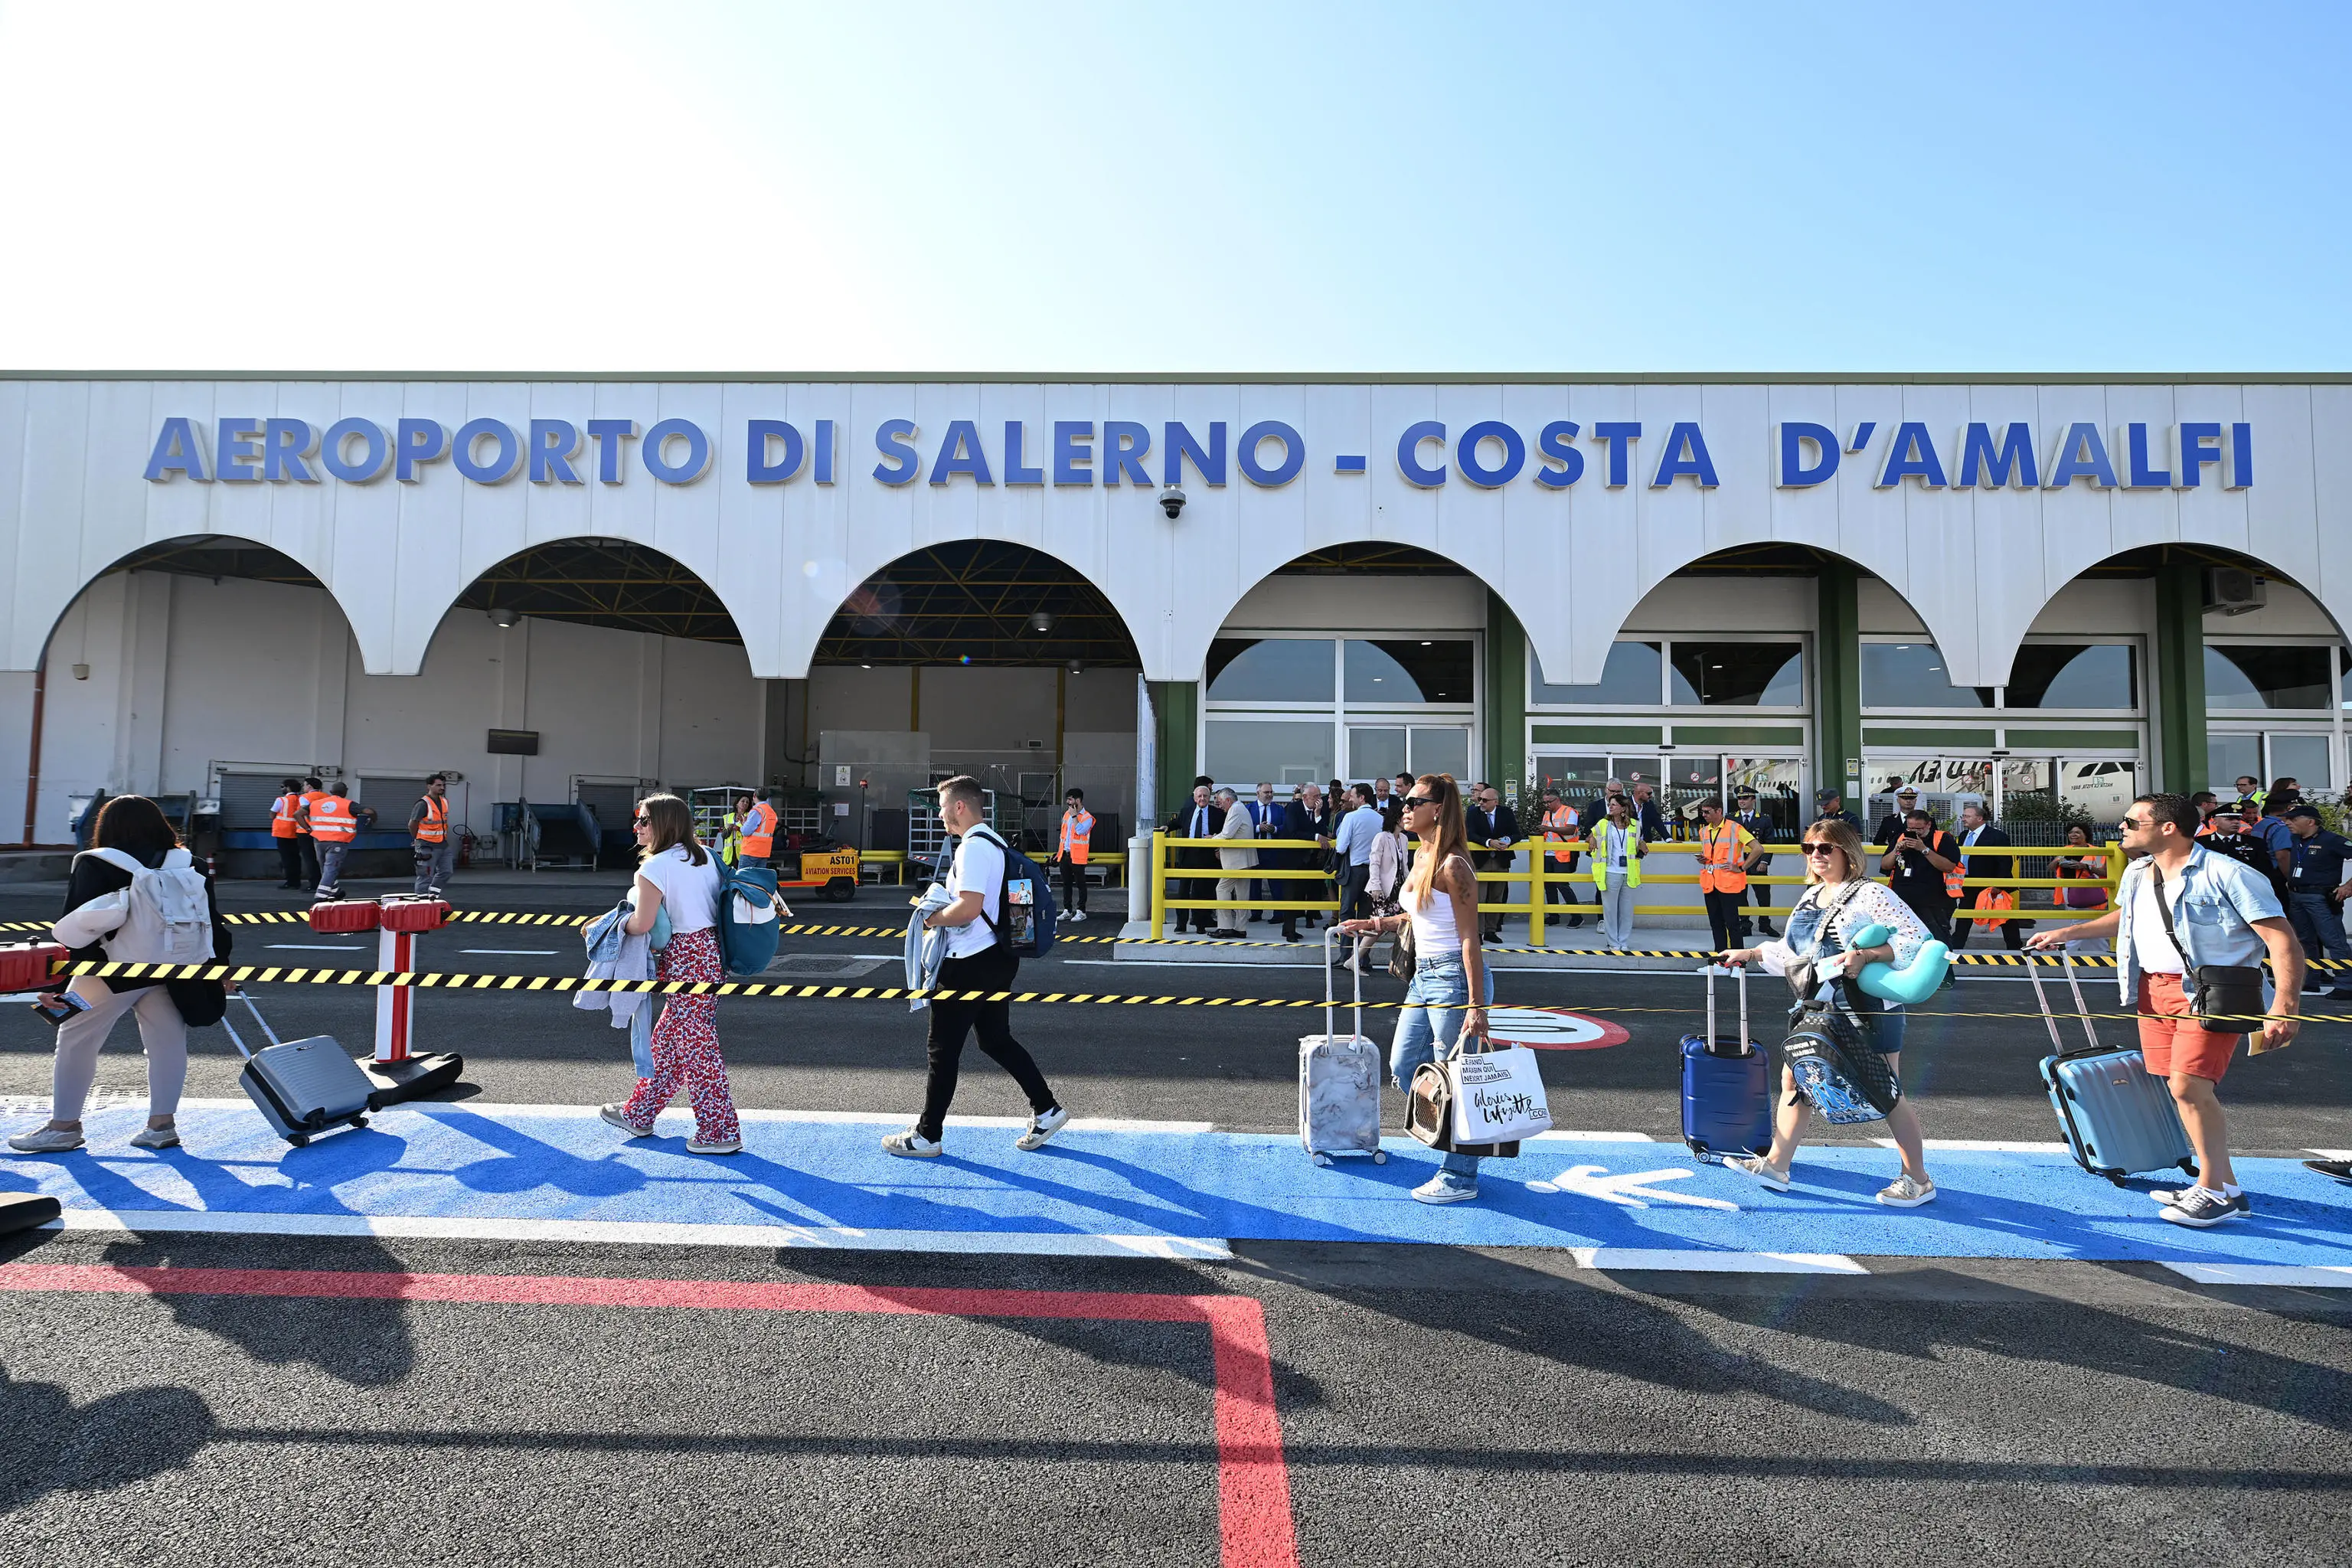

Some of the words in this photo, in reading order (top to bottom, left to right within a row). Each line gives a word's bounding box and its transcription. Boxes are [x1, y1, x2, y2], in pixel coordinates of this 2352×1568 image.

[145, 418, 710, 485] AEROPORTO
[748, 420, 835, 484] DI
[874, 420, 1305, 486] SALERNO
[1335, 455, 1367, 473] -
[1398, 420, 1720, 488] COSTA
[1778, 421, 2254, 490] D'AMALFI
[830, 856, 854, 864] AST01
[1485, 1072, 1508, 1081] JAMAIS
